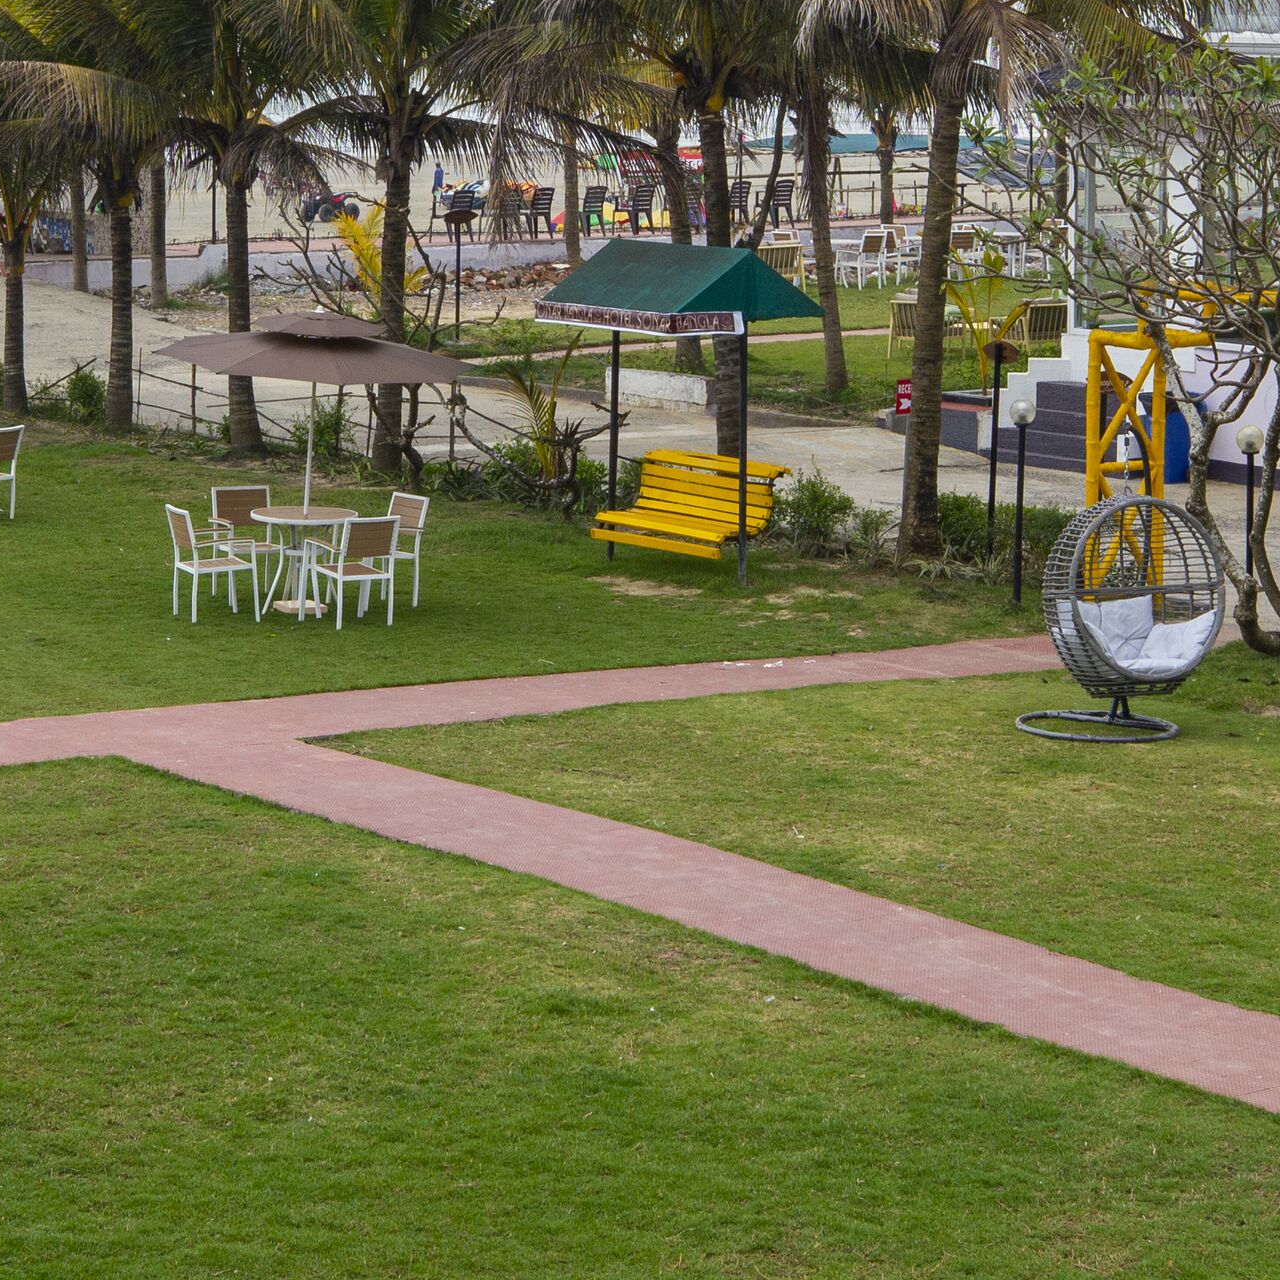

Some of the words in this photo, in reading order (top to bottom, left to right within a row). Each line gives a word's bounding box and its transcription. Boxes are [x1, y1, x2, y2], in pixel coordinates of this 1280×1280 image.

[602, 309, 635, 328] HOTEL
[636, 311, 671, 333] SONAR
[676, 314, 720, 331] BANGLA
